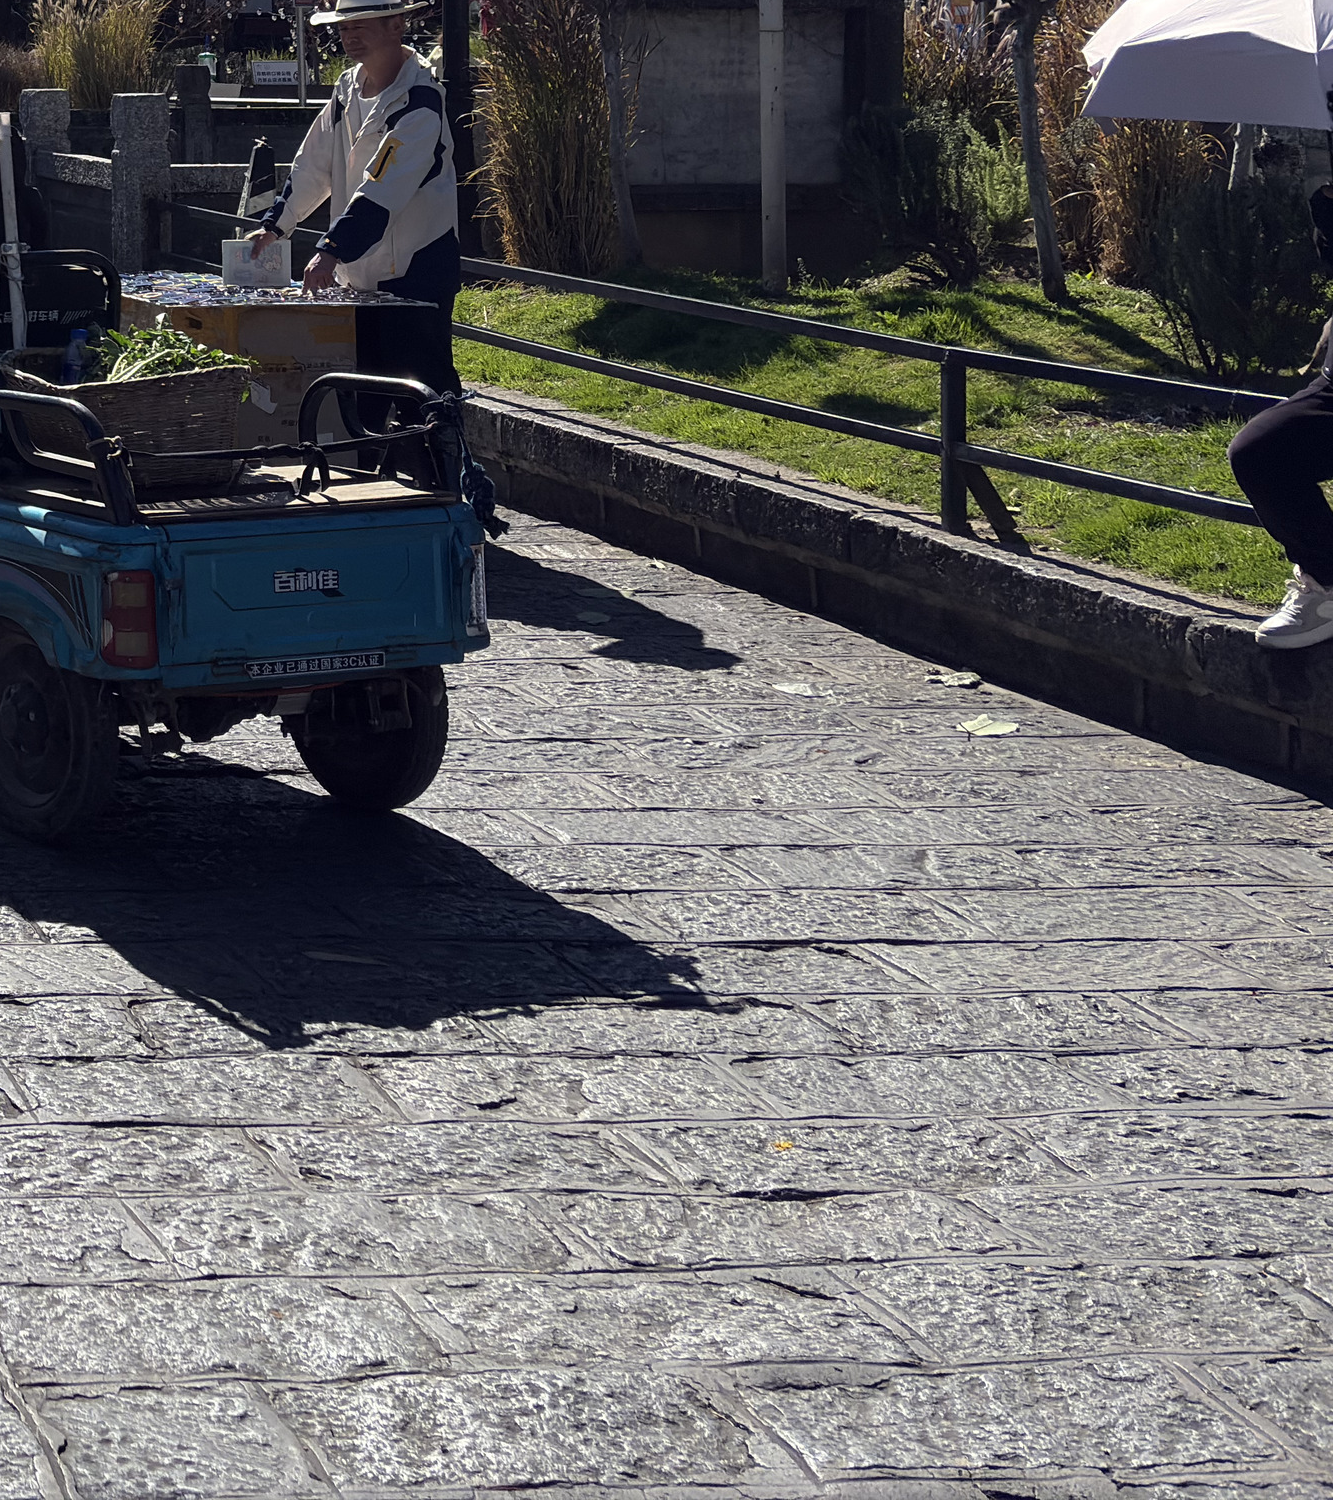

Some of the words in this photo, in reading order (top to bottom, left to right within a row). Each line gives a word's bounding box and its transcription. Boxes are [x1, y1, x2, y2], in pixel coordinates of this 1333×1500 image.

[273, 568, 339, 594] 百利佳
[250, 654, 381, 676] 本企业已通过国家3C认证
